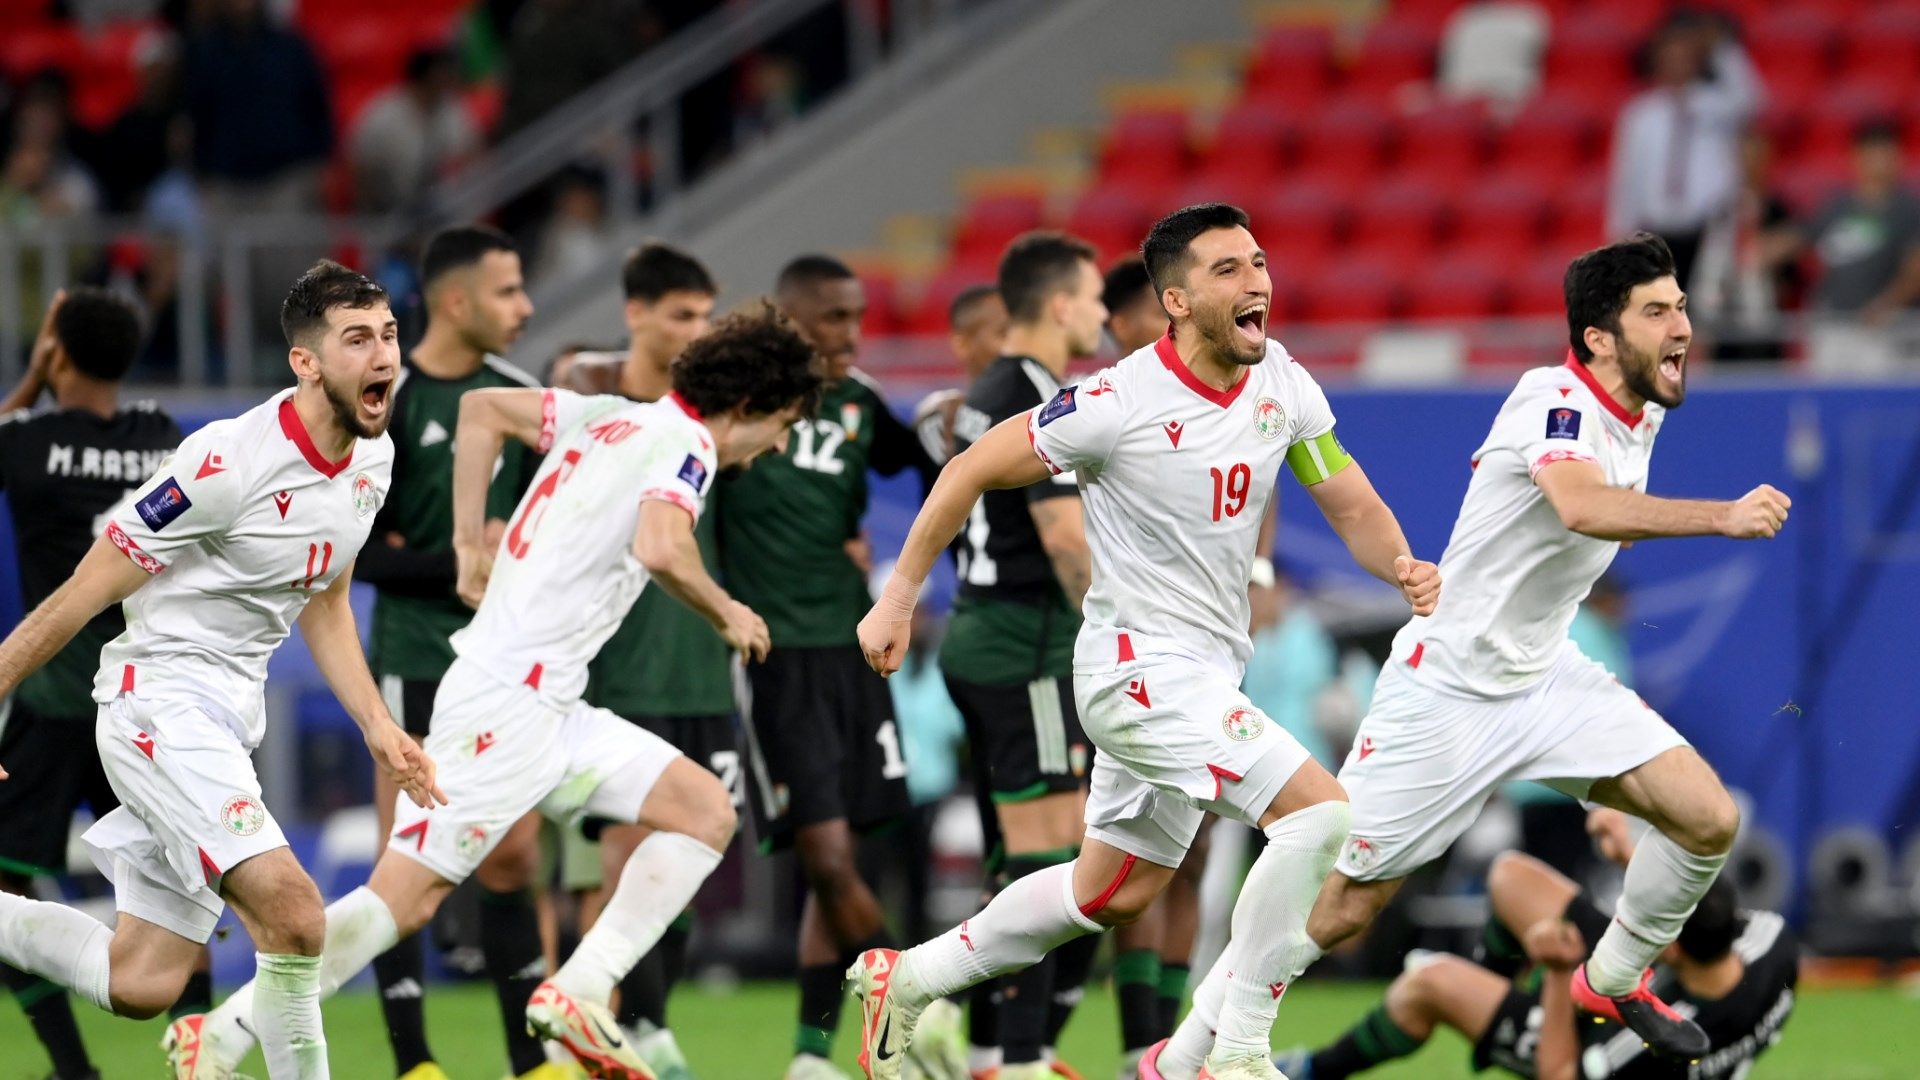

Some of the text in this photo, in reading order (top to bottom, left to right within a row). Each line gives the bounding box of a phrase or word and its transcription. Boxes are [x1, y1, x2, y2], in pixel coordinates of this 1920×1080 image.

[46, 442, 177, 482] M.RASH
[792, 417, 846, 476] 12
[1209, 462, 1251, 522] 19
[290, 541, 333, 588] 11
